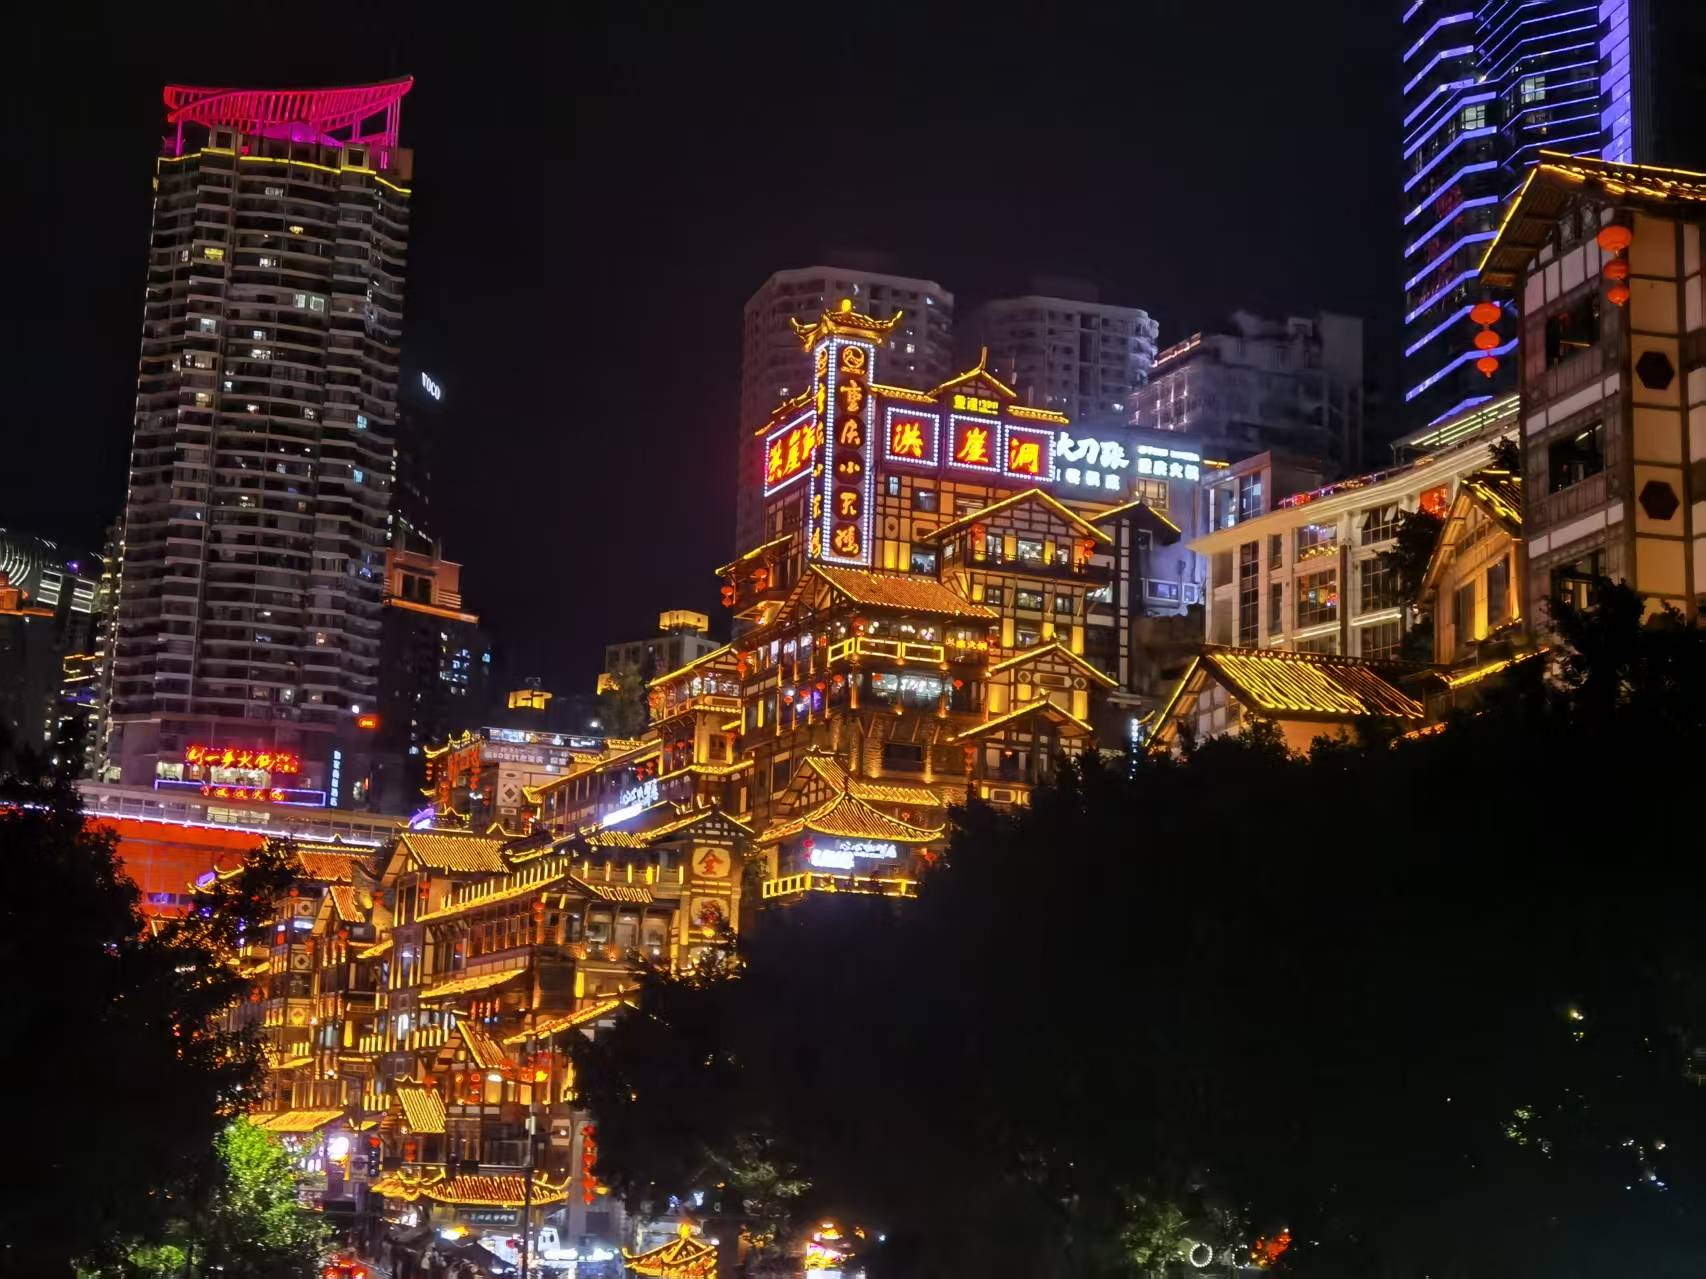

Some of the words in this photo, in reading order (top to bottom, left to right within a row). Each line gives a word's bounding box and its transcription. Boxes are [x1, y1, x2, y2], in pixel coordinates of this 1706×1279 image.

[834, 380, 862, 555] 重庆小天鹅
[893, 423, 1039, 473] 洪崖洞
